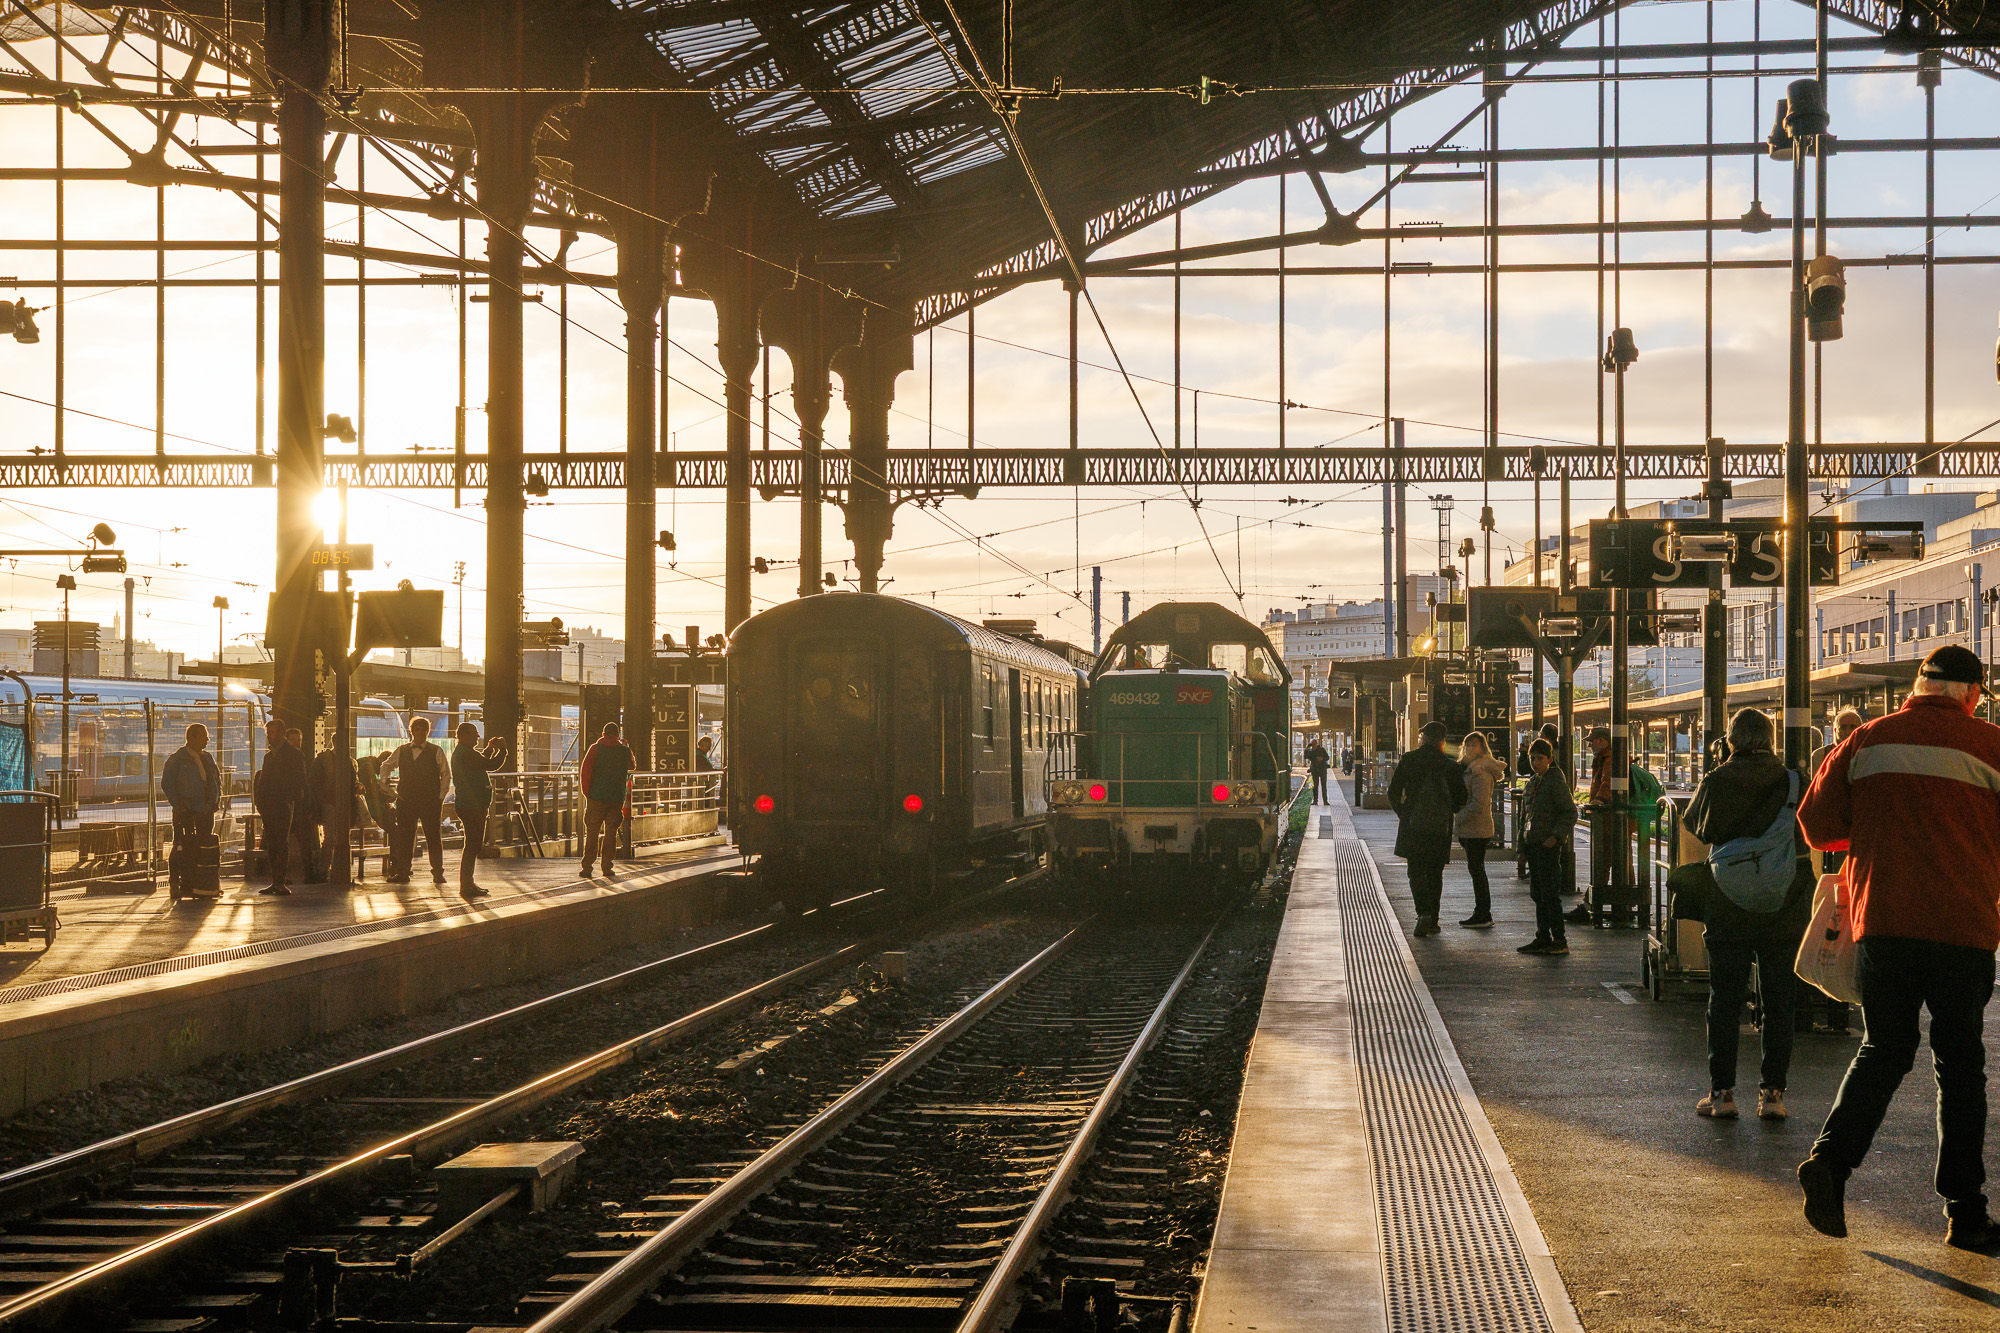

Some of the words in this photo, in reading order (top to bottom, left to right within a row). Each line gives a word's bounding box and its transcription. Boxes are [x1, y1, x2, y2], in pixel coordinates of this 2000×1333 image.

[312, 551, 350, 564] 08:55
[1651, 535, 1682, 583] S
[1750, 534, 1784, 582] S
[669, 664, 682, 682] T
[706, 664, 719, 682] T
[1108, 692, 1160, 705] 469432
[1176, 691, 1211, 702] SNCF
[658, 711, 668, 722] U
[676, 711, 685, 722] Z
[1477, 707, 1488, 719] U
[1496, 707, 1506, 719] Z
[659, 758, 667, 770] S
[677, 758, 686, 770] R
